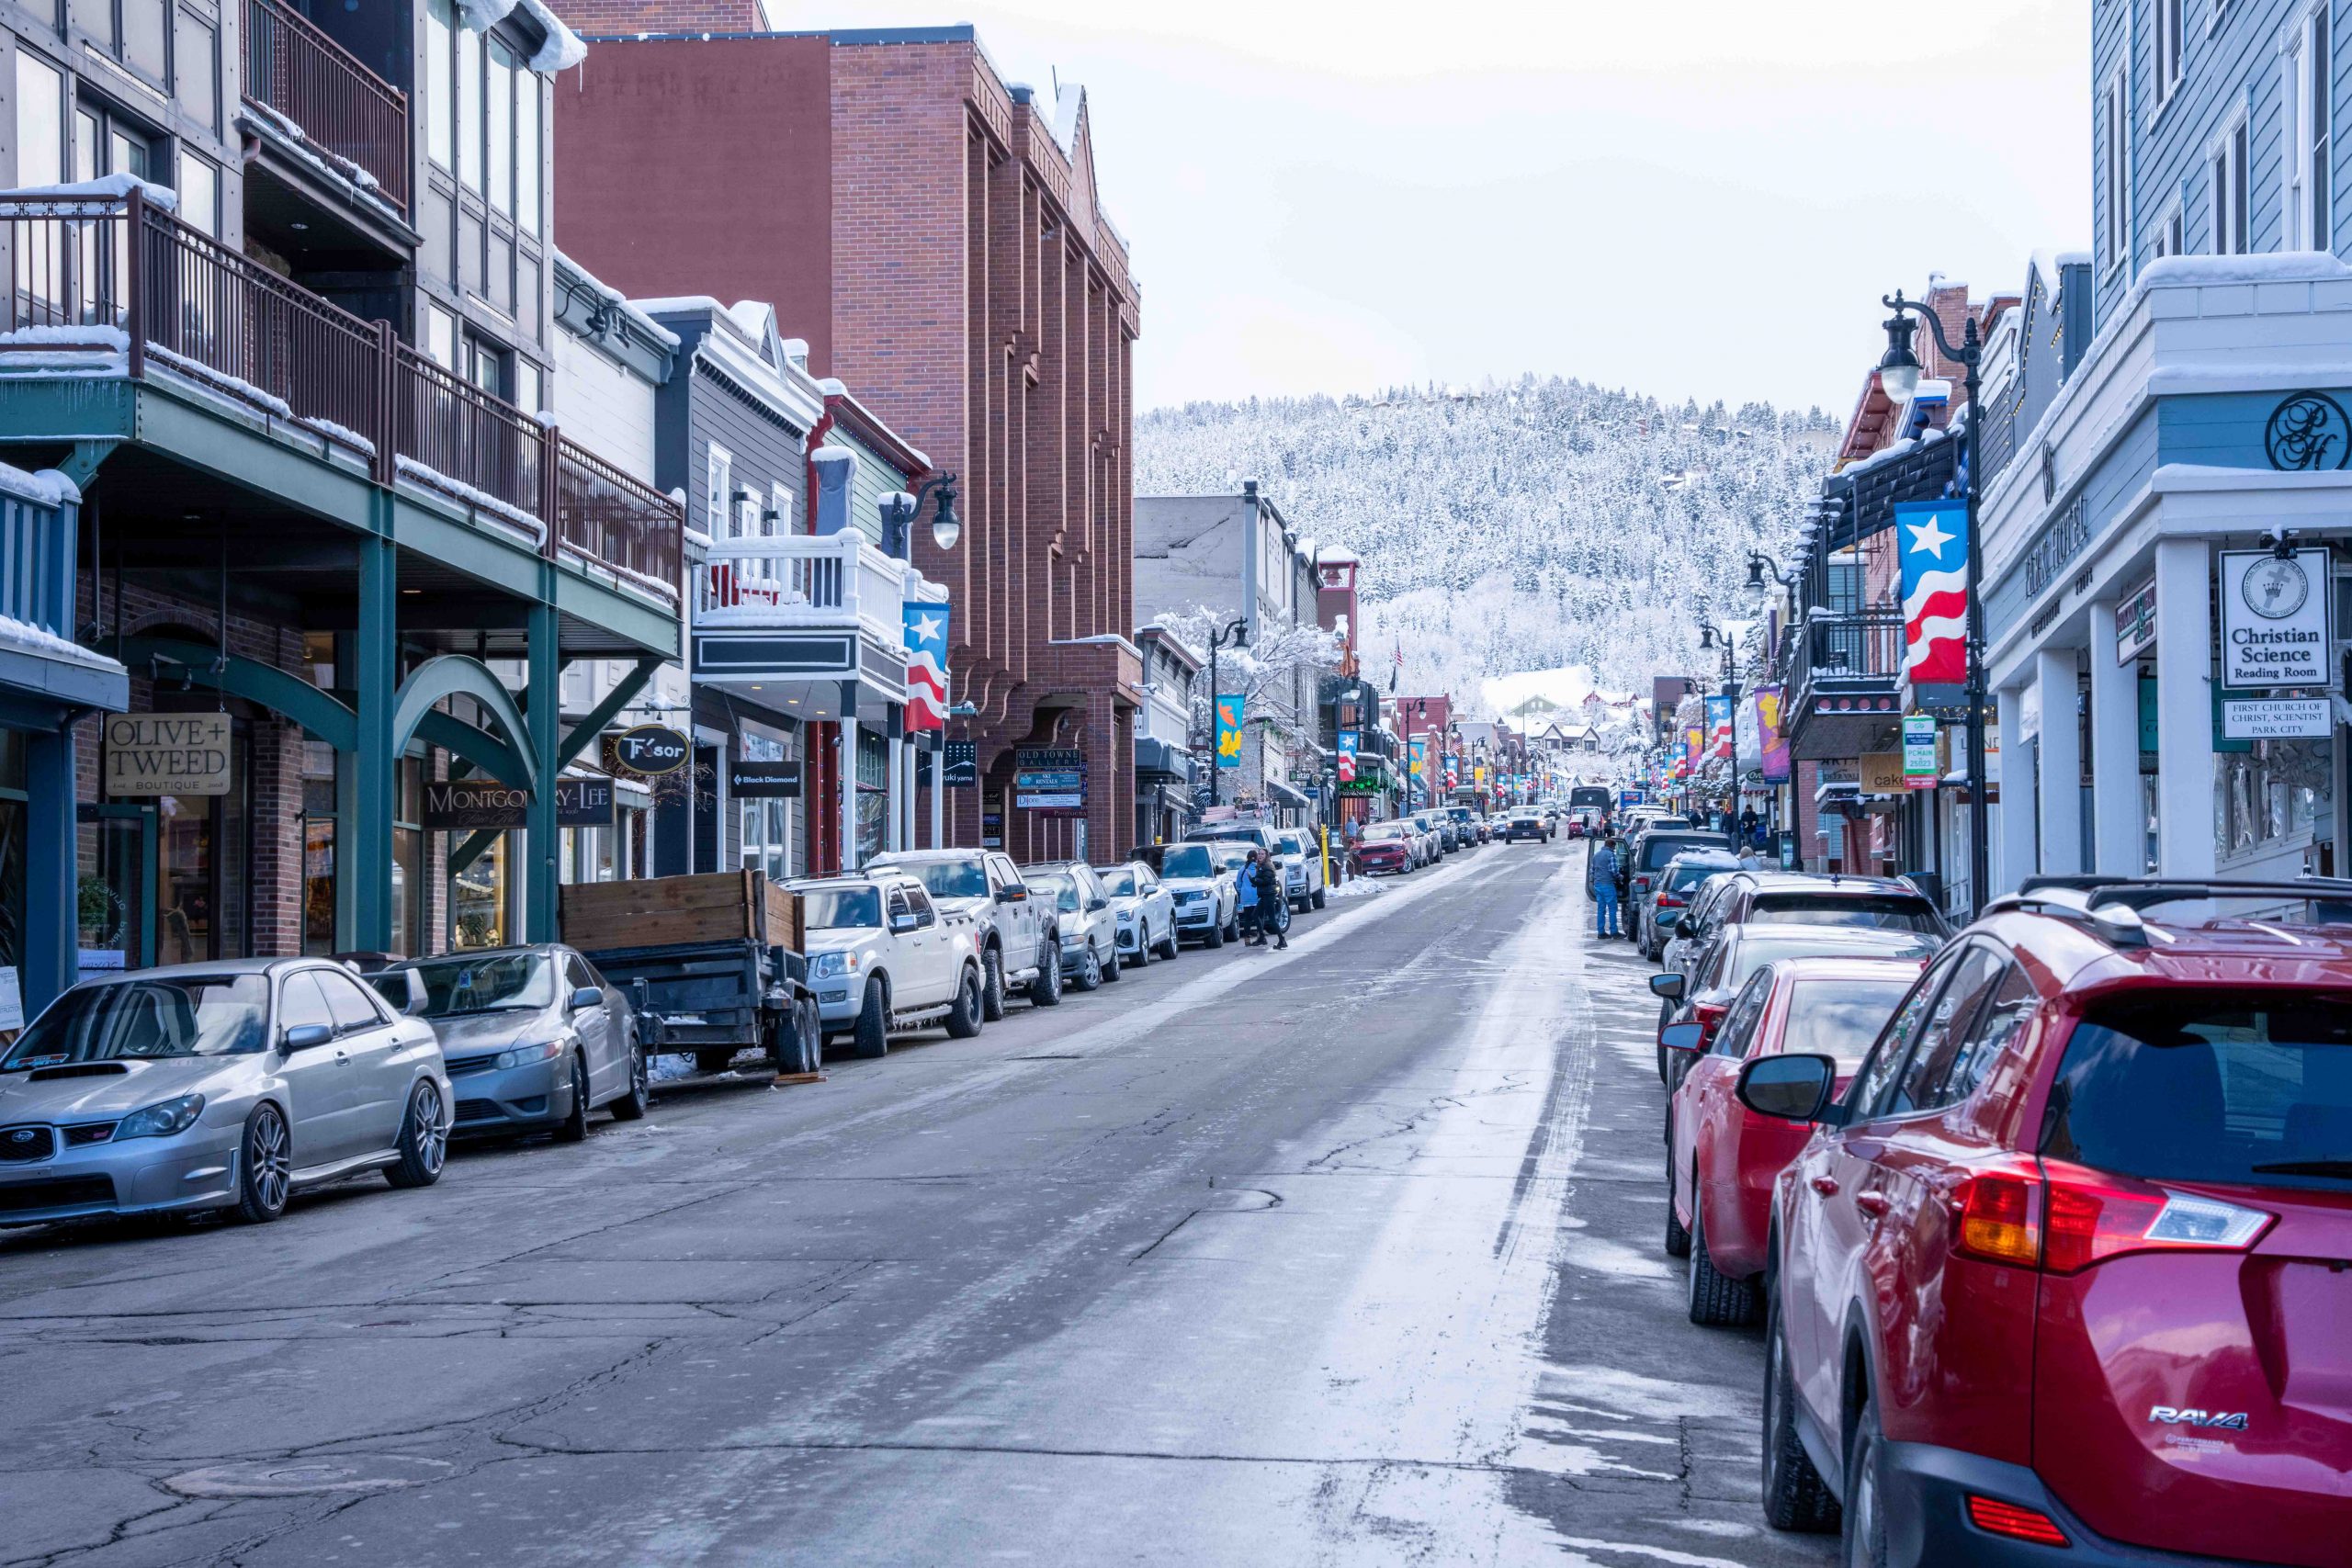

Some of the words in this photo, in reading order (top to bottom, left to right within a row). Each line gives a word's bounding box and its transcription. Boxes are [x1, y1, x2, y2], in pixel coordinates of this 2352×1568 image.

[2052, 494, 2087, 573] HOTEL
[2232, 627, 2320, 644] Christian
[2242, 647, 2312, 663] Science
[2234, 667, 2279, 679] Reading
[2284, 667, 2317, 677] Room
[2233, 704, 2259, 712] FIRST
[2262, 703, 2306, 712] CHURCH
[2309, 703, 2323, 711] OF
[2232, 714, 2270, 723] CHRIST,
[2273, 713, 2324, 721] SCIENTIST
[2252, 726, 2278, 734] PARK
[2280, 726, 2304, 734] CITY
[1019, 750, 1039, 759] OLD
[110, 750, 225, 775] TWEED
[136, 781, 199, 790] BOUTIQUE
[2148, 1405, 2249, 1431] RAV4
